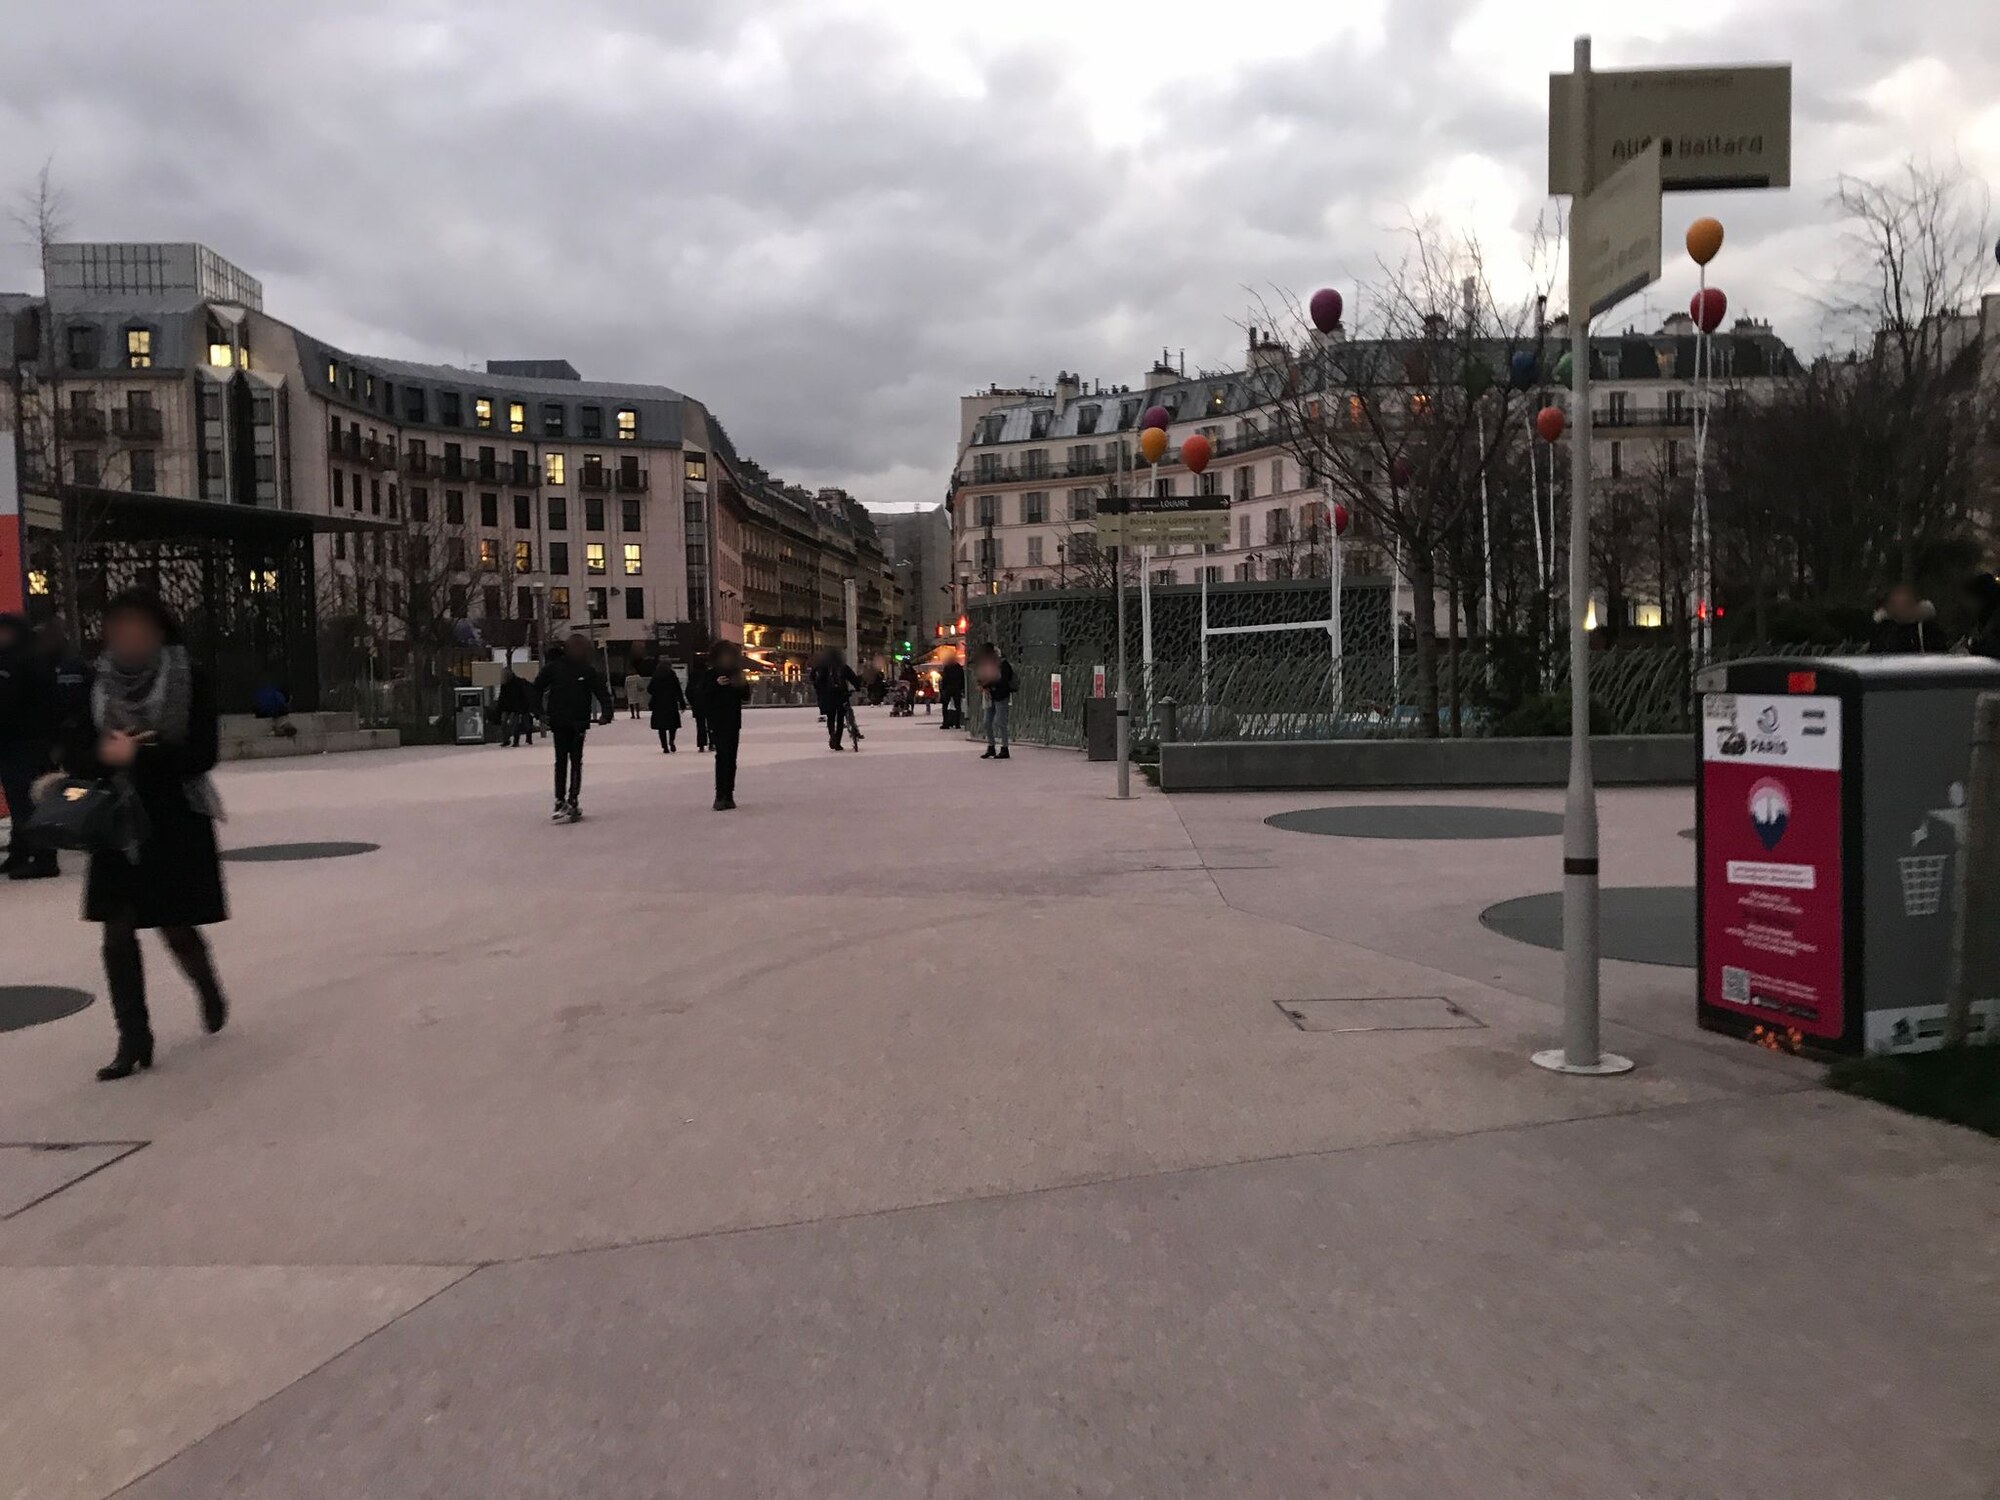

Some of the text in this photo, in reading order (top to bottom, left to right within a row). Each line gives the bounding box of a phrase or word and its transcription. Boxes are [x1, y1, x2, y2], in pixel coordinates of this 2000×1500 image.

[1160, 500, 1190, 508] LOUVRE
[1168, 516, 1210, 525] Commerce
[1750, 738, 1788, 756] PARIS
